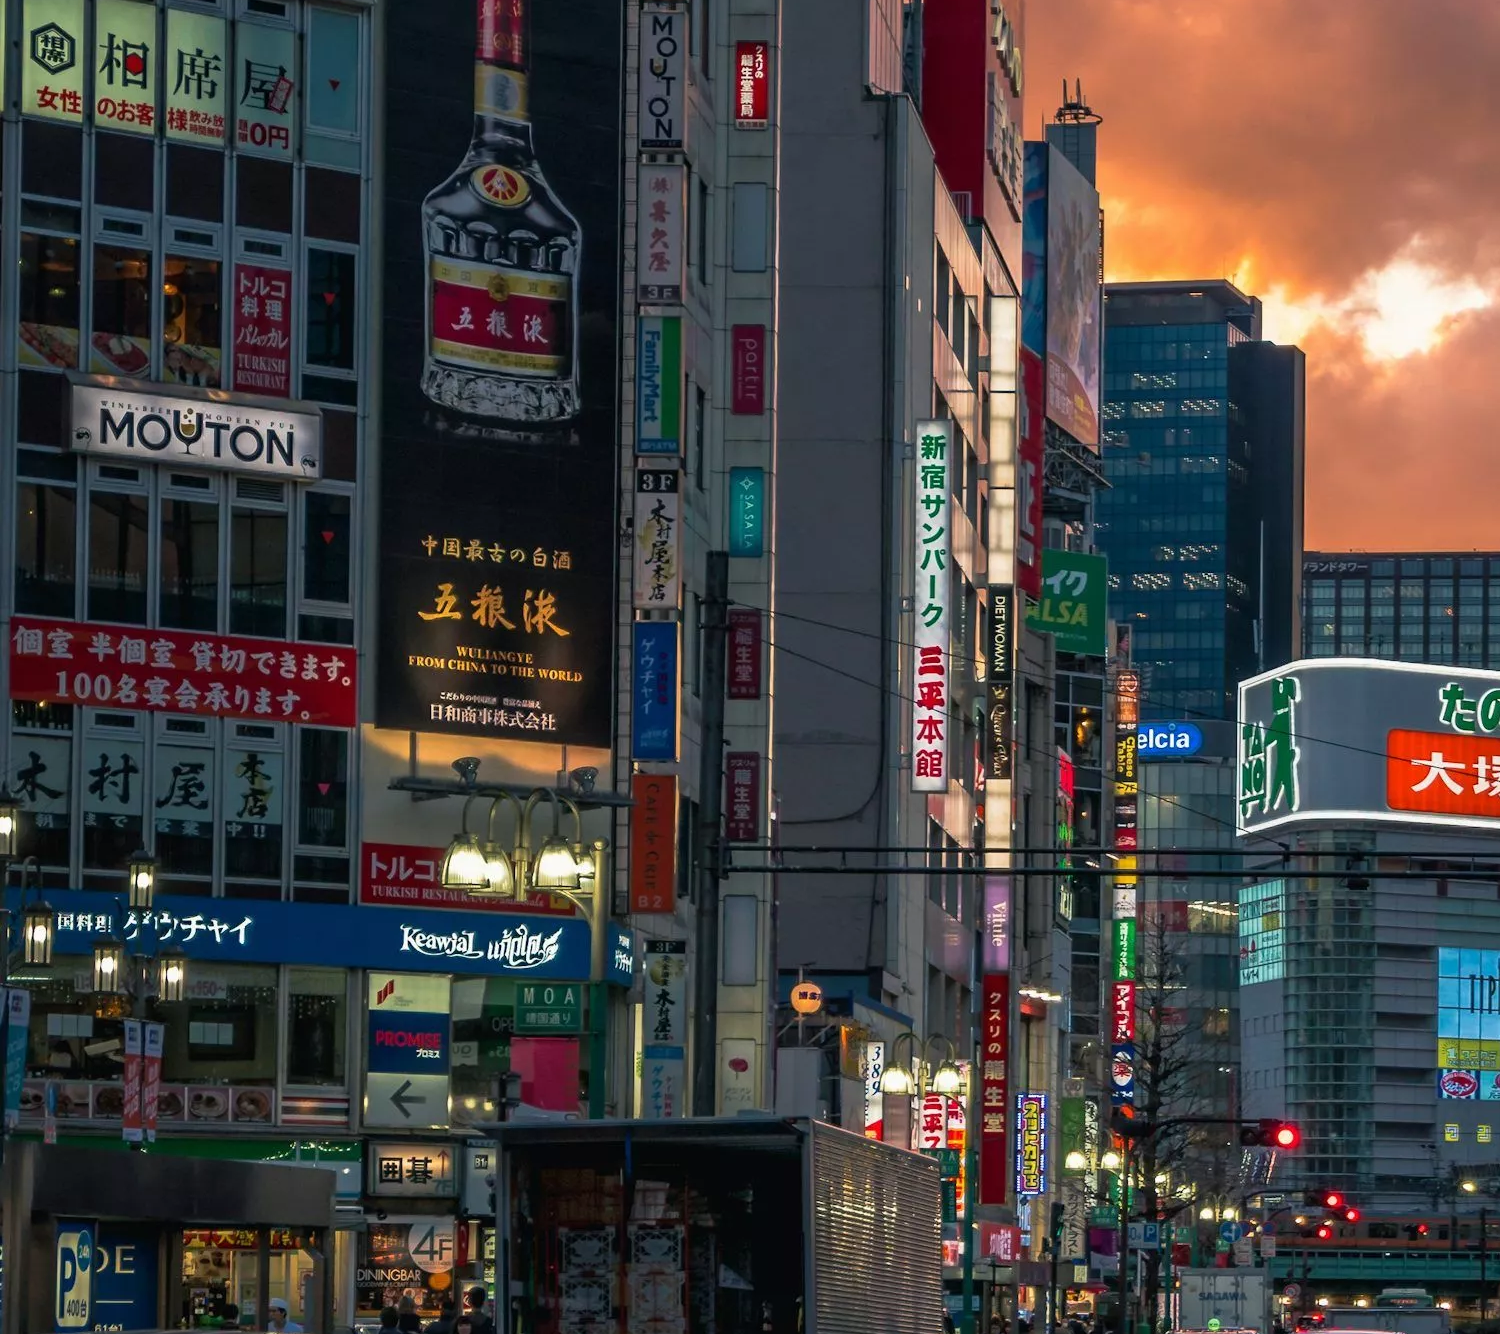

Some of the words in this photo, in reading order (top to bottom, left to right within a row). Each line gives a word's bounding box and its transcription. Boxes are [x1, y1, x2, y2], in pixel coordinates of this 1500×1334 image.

[98, 32, 293, 114] 相席屋
[649, 15, 678, 139] MOUTON
[754, 44, 764, 79] クスリの
[36, 85, 188, 133] 女性のお客様
[249, 121, 290, 151] 0円
[238, 275, 287, 299] トルコ
[647, 286, 672, 299] 3F
[240, 299, 284, 322] 料理
[451, 306, 549, 345] 五粮液
[235, 323, 290, 351] パムッカレ
[235, 370, 288, 391] RESTAURANT
[236, 353, 287, 375] TURKISH
[642, 330, 661, 423] FamilyMart
[738, 337, 759, 401] partir
[99, 408, 295, 468] MOUTON
[641, 473, 674, 491] 3F
[744, 493, 755, 549] SASALA
[919, 434, 947, 629] 新宿サンパーク
[420, 534, 573, 572] 中国最古の白酒
[644, 498, 675, 602] 木村屋本店
[1041, 569, 1088, 597] イク
[417, 581, 571, 638] 五粮液
[994, 596, 1006, 621] DIET
[12, 624, 76, 660] 個室
[87, 631, 177, 670] 半個室
[188, 638, 352, 687] 貸切できます。
[455, 644, 534, 665] WULIANGYE
[734, 628, 753, 682] 龍生堂
[994, 623, 1006, 673] WOMAN
[407, 654, 446, 670] FROM
[447, 658, 488, 675] CHINA
[491, 663, 508, 676] TO
[509, 664, 535, 679] THE
[537, 667, 584, 684] WORLD
[639, 638, 656, 715] ゲウチャイ
[54, 669, 311, 721] 100名宴会承ります。
[915, 645, 946, 779] 三平本館
[428, 703, 557, 732] 日和商事株式会社
[1115, 740, 1125, 774] Table
[1125, 736, 1135, 778] Cheese
[1136, 730, 1190, 751] elcia
[13, 750, 209, 813] 木村屋
[236, 752, 273, 820] 本店
[733, 769, 752, 820] 龍生堂
[370, 884, 420, 901] TURKISH
[637, 895, 664, 909] B2
[991, 901, 1007, 947] Vitule
[655, 942, 677, 953] 3F
[523, 986, 575, 1005] MOA
[653, 989, 677, 1034] 木村屋
[525, 1011, 572, 1026] 靖国通り
[987, 991, 1001, 1055] クスリの
[375, 1029, 442, 1050] PROMISE
[415, 1048, 441, 1060] プロミス
[983, 1059, 1005, 1133] 龍生堂
[1021, 1100, 1041, 1189] ネットカフェ
[379, 1156, 433, 1184] 囲碁
[412, 1225, 453, 1262] 4F
[1145, 1225, 1156, 1239] P
[78, 1245, 91, 1260] 24h
[356, 1268, 421, 1282] DININGBAR
[66, 1299, 88, 1318] 400台
[1197, 1290, 1248, 1301] SAGAWA
